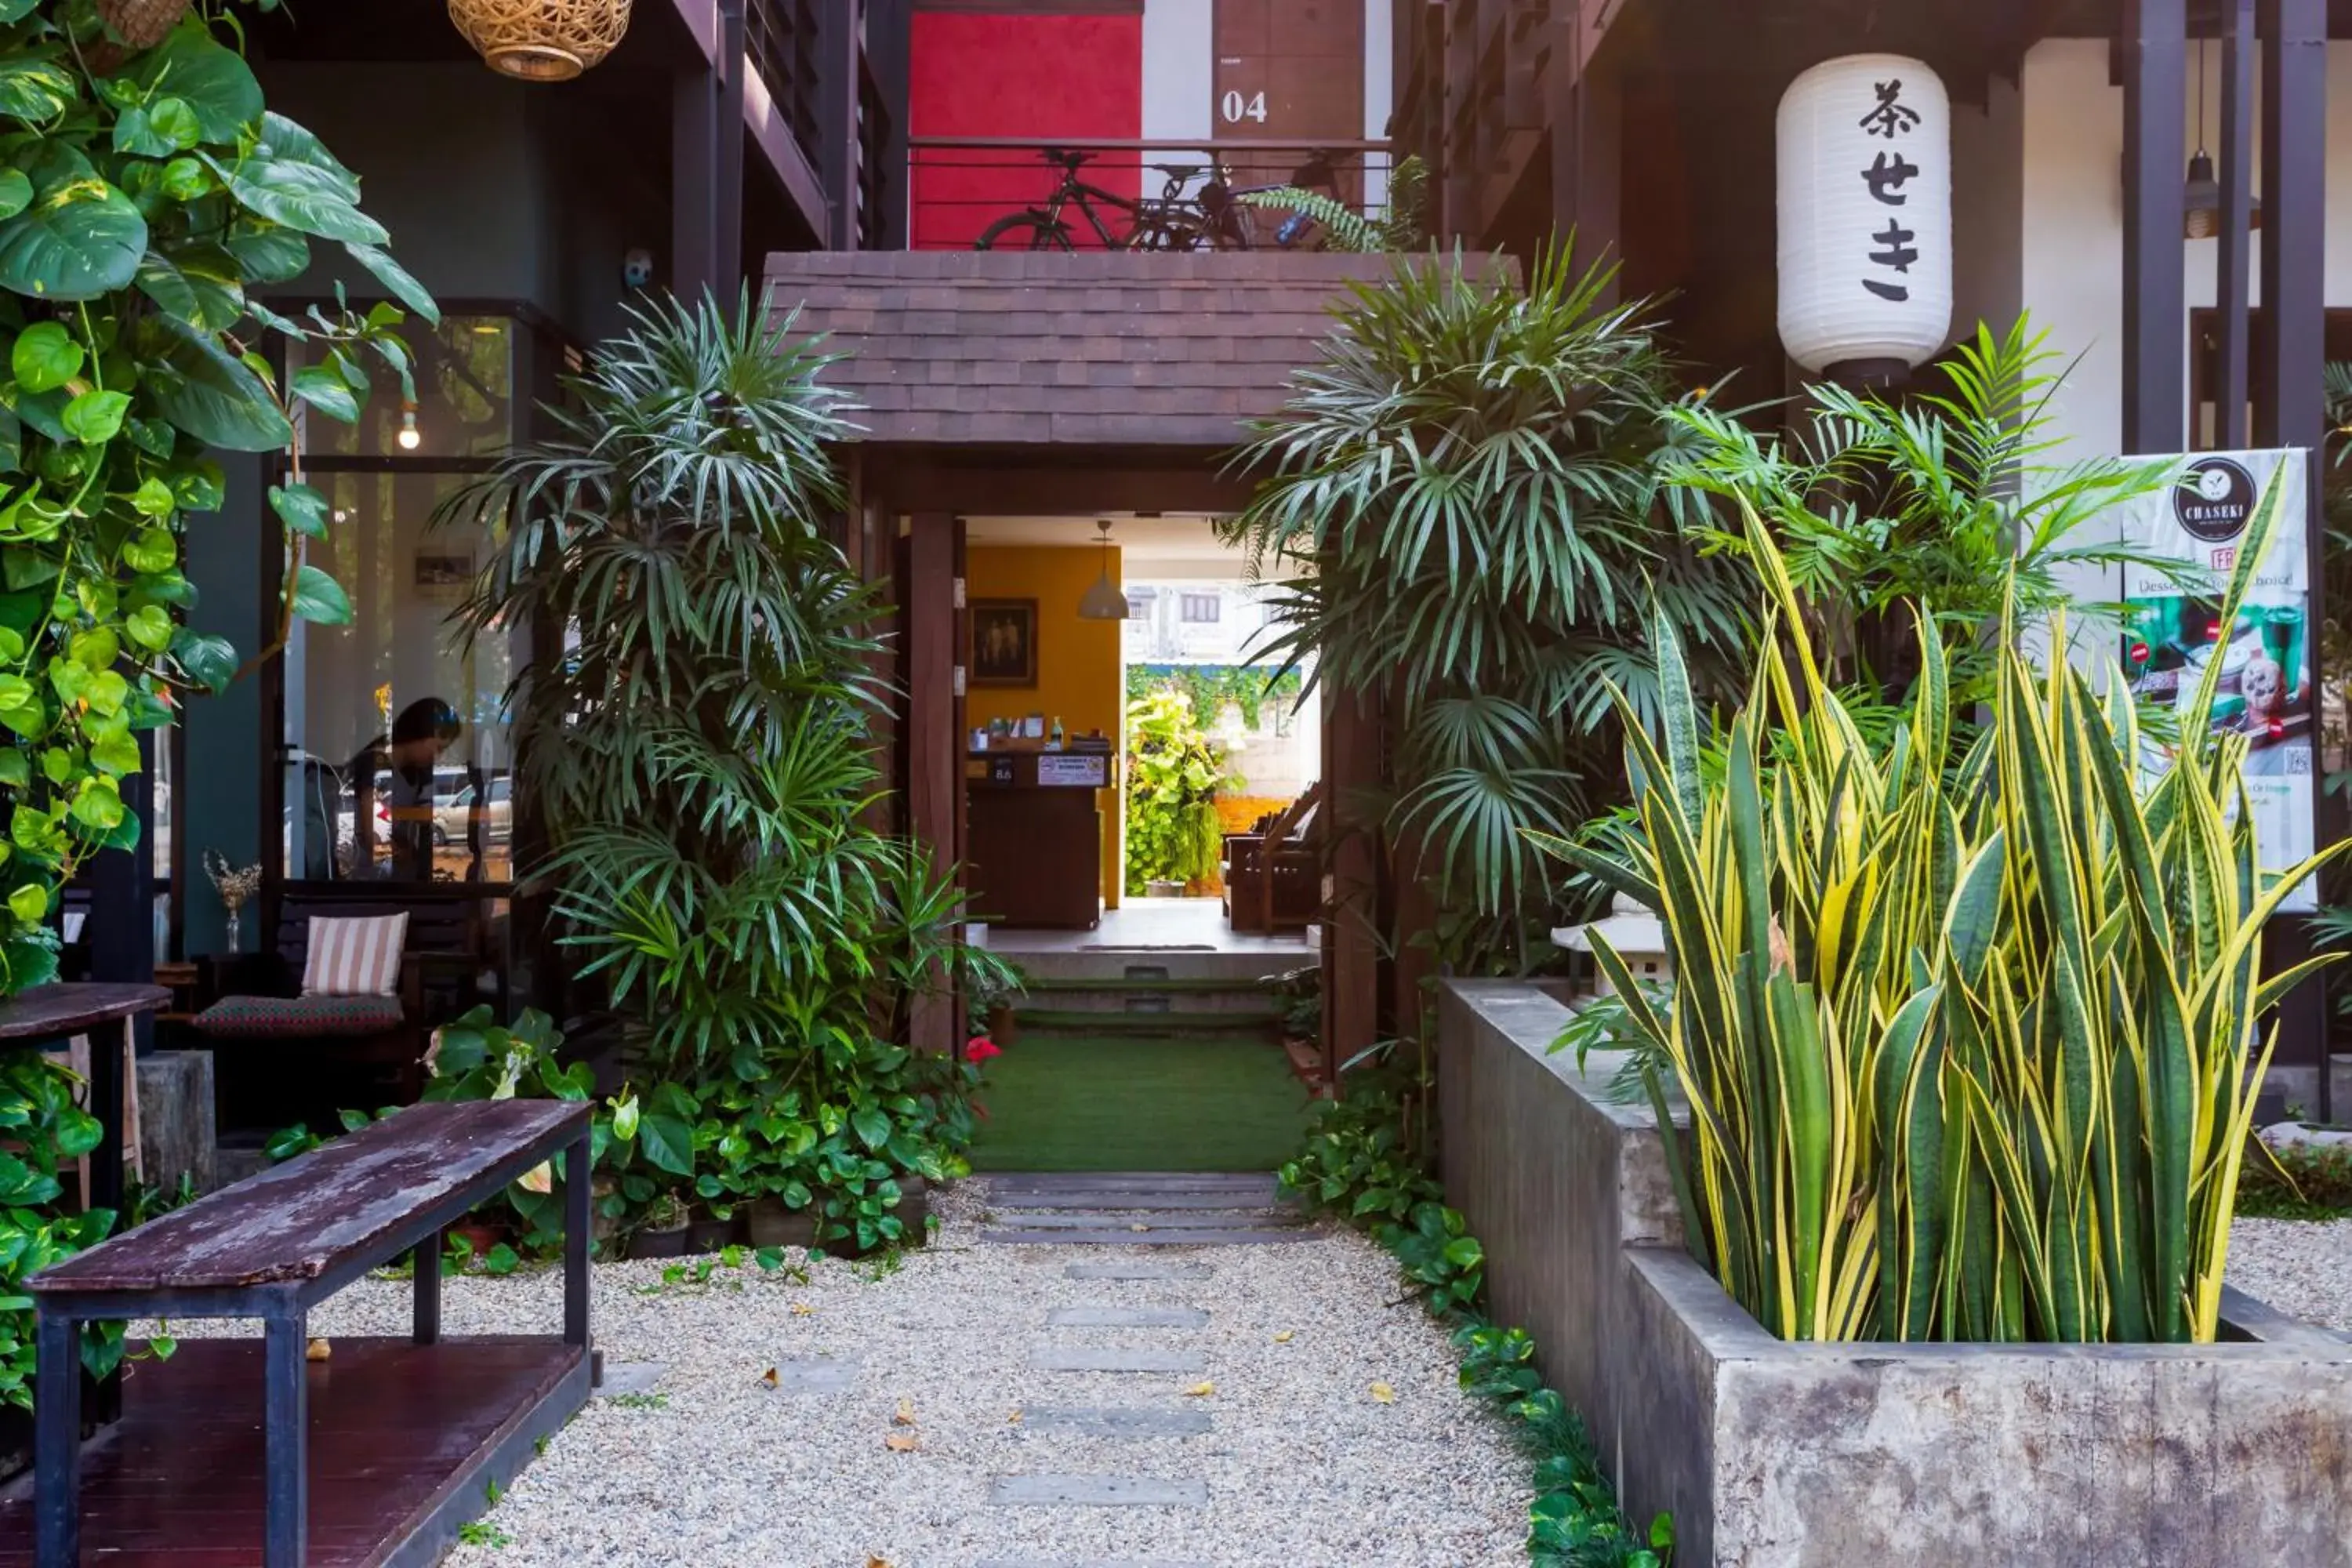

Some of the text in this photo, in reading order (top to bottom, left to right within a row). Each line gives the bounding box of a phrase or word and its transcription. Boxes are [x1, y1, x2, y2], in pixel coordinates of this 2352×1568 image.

[1222, 90, 1268, 123] 04
[1859, 78, 1922, 302] 茶せき
[2185, 504, 2243, 519] CHASEKI
